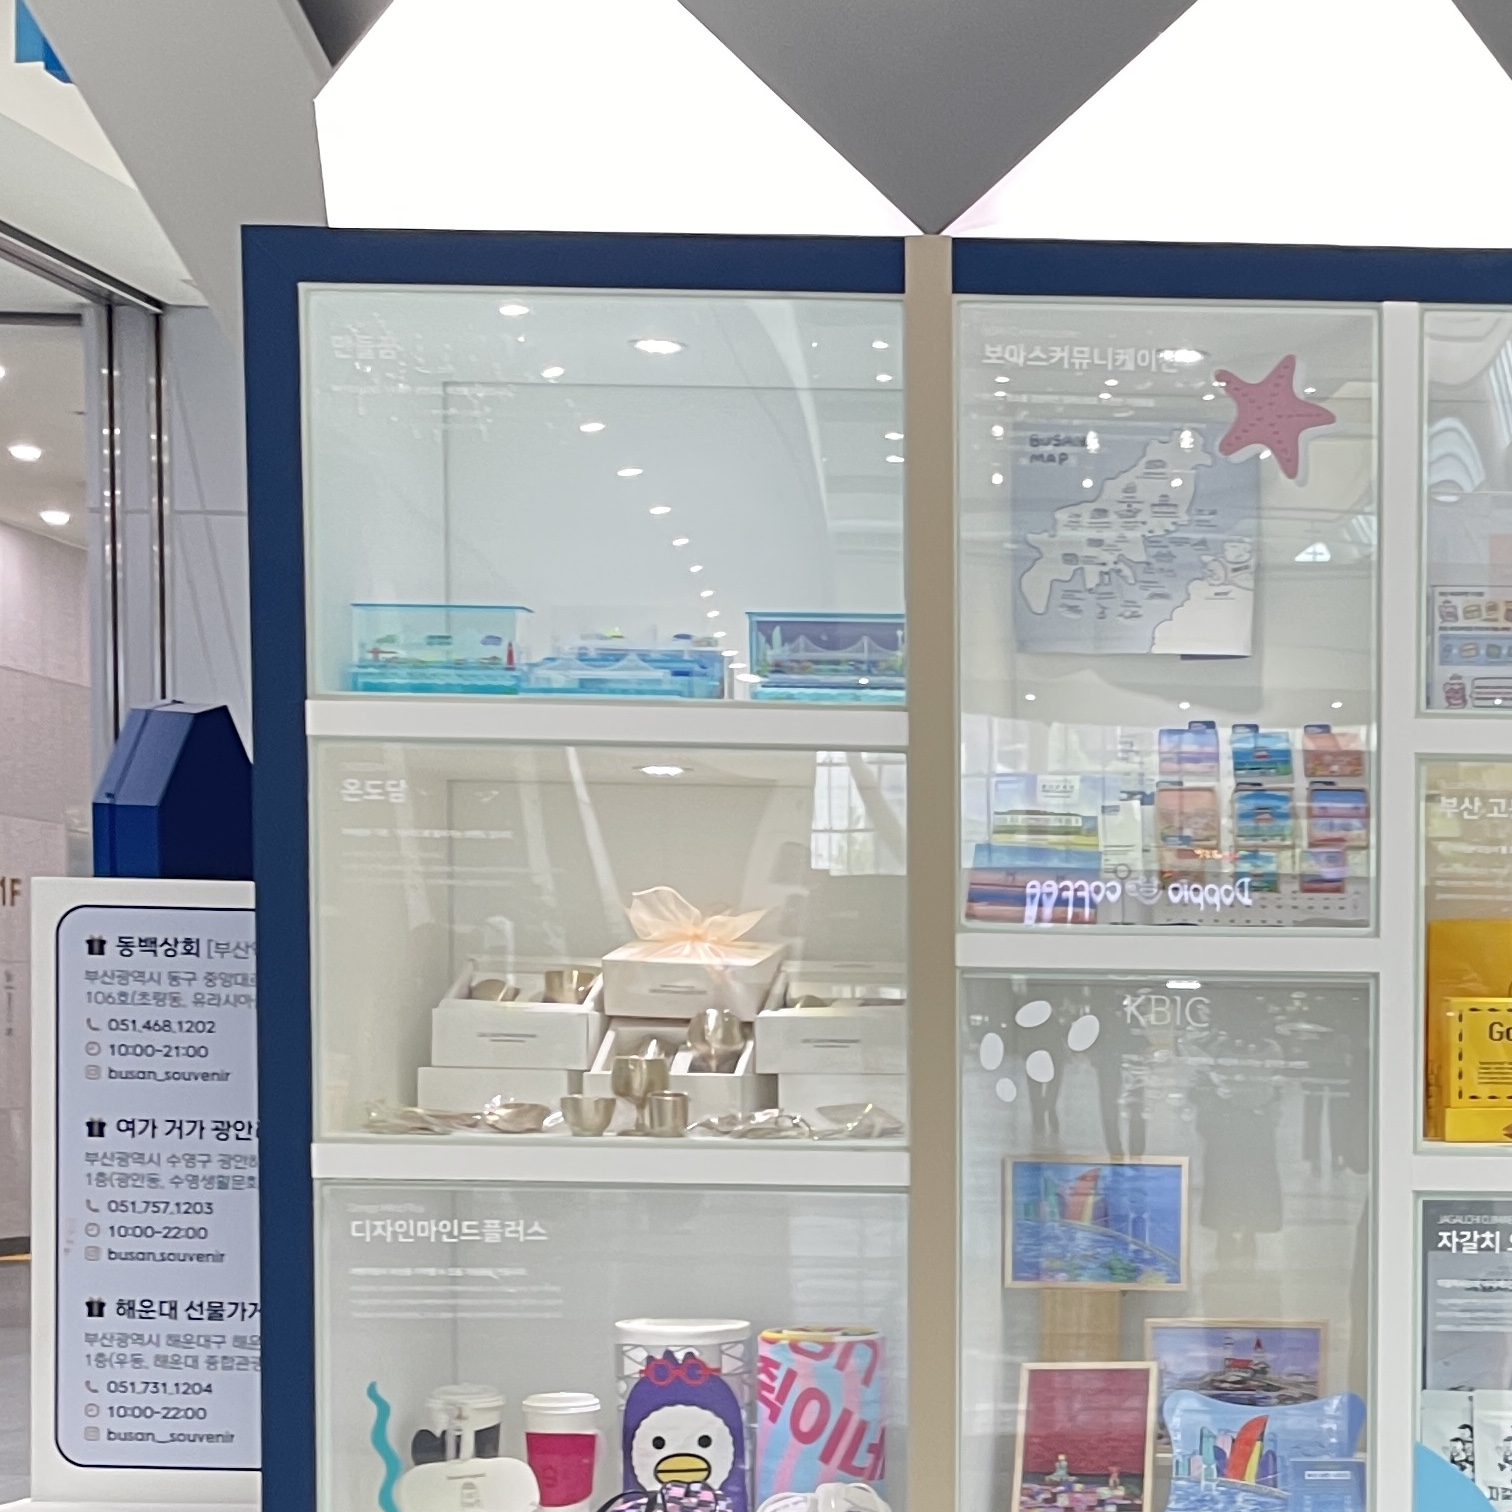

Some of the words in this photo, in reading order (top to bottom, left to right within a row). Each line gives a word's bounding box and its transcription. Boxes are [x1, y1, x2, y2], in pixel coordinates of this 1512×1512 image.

[1029, 453, 1069, 466] MAP
[340, 778, 408, 803] 온도담
[1440, 796, 1482, 820] 부산
[116, 936, 200, 957] 동백상회
[109, 1043, 209, 1058] 10:00-21:00
[116, 1118, 158, 1139] 여가
[164, 1119, 205, 1140] 거가
[211, 1120, 259, 1142] 광안
[108, 1225, 209, 1240] 10:00-22:00
[350, 1218, 549, 1243] 디자인마인드플러스
[1437, 1230, 1500, 1254] 자갈치
[116, 1299, 178, 1320] 해운대
[107, 1405, 208, 1420] 10:00-22:00
